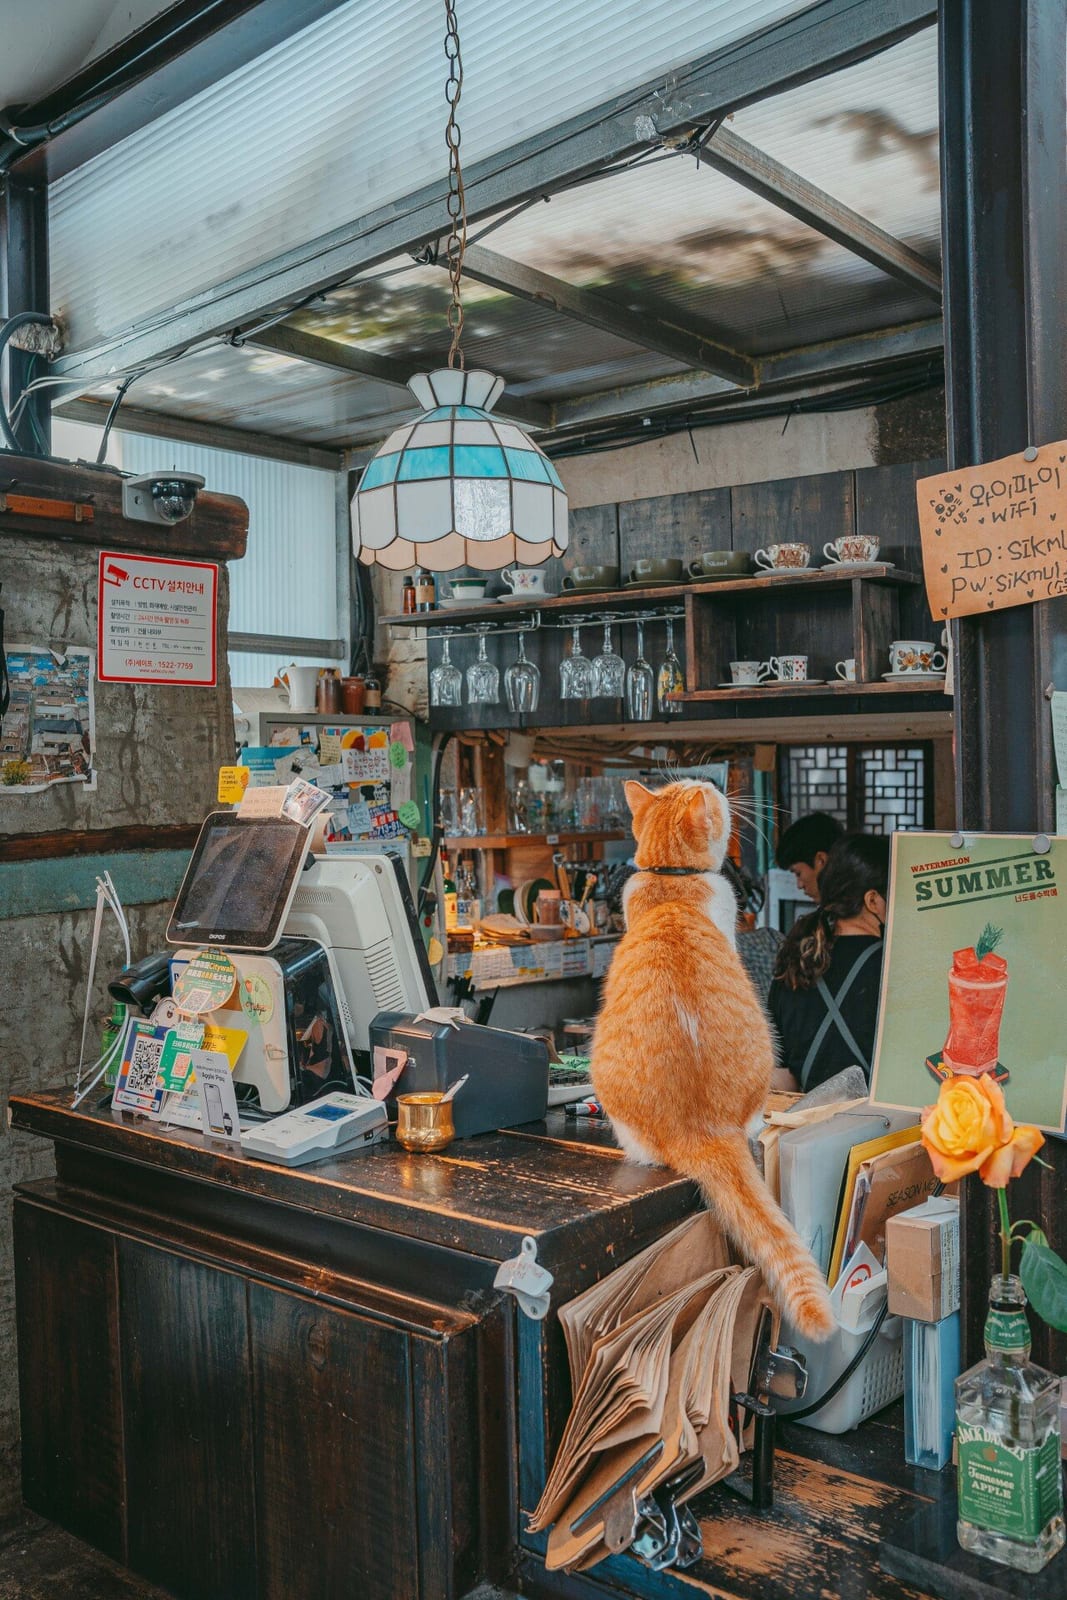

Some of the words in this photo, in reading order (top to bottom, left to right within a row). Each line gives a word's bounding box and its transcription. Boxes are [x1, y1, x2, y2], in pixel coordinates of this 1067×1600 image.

[133, 576, 166, 590] CCTV
[910, 856, 970, 873] WATERMELON
[915, 859, 1055, 902] SUMMER
[958, 1425, 984, 1445] JACK
[971, 1479, 1012, 1500] APPLE
